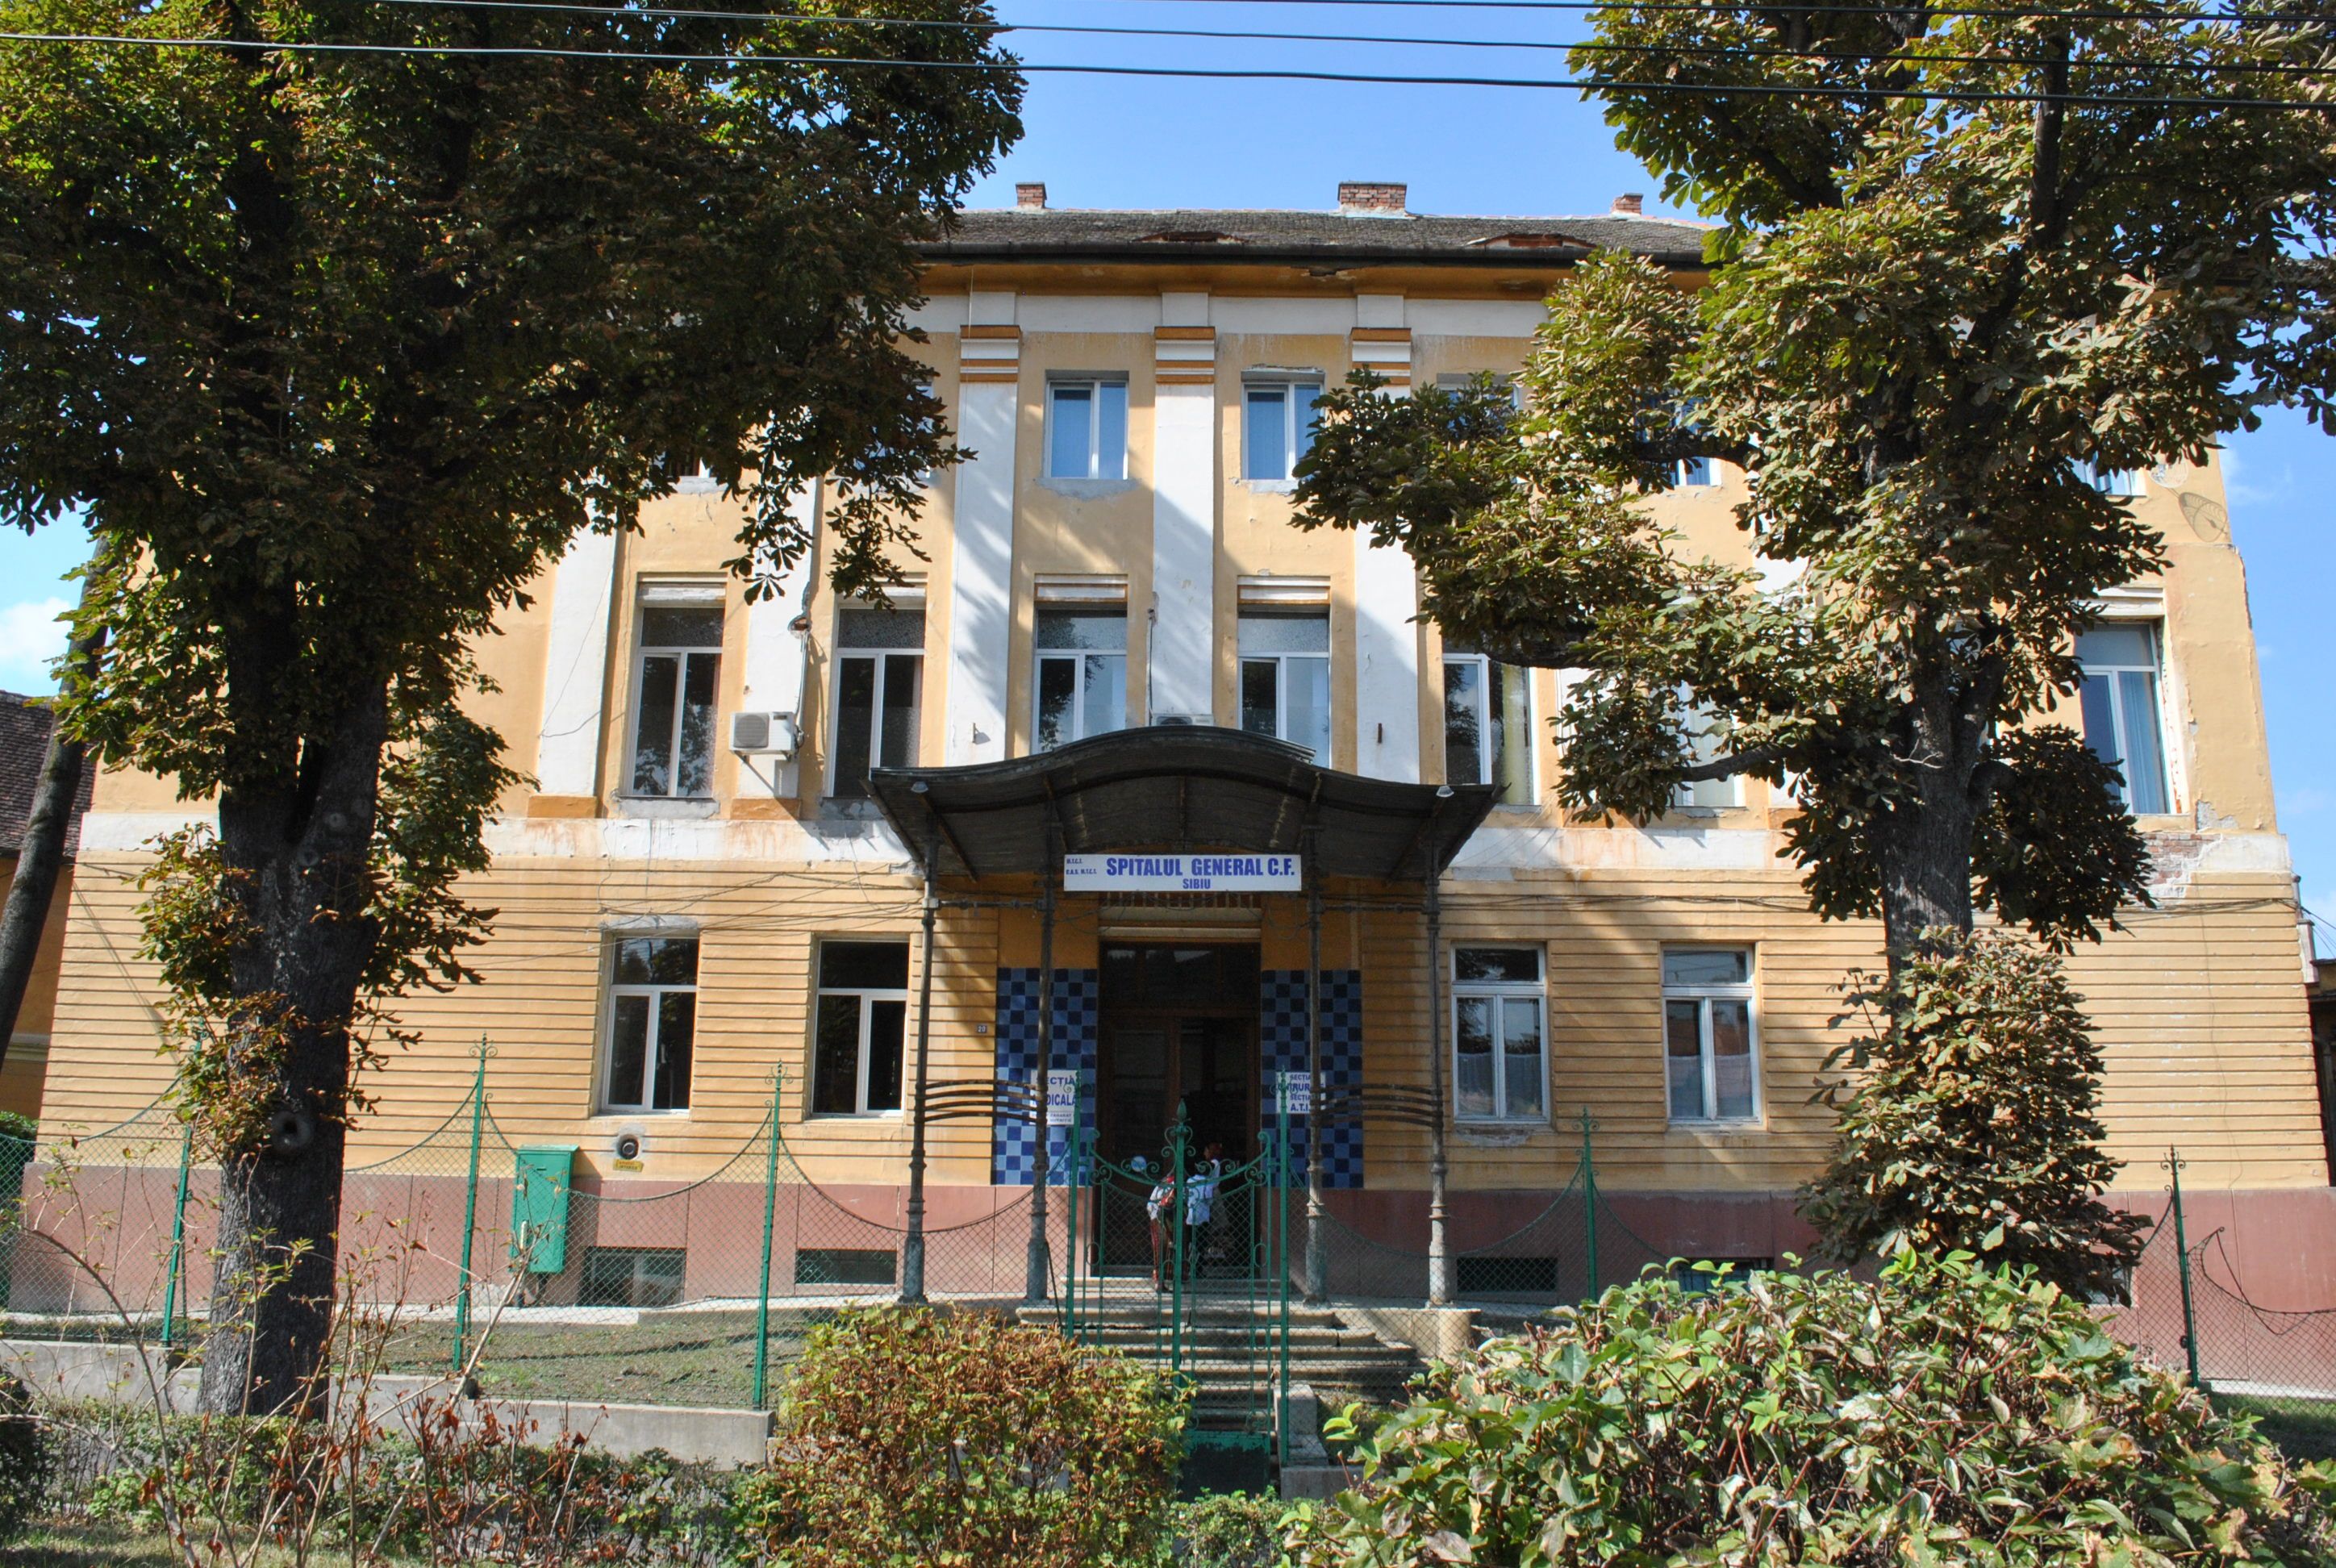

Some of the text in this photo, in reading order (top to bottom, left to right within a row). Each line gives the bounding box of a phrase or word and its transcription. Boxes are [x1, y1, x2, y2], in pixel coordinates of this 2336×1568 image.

[1106, 857, 1295, 876] SPITALUL GENERAL C.F.
[1183, 878, 1211, 890] SIBIU
